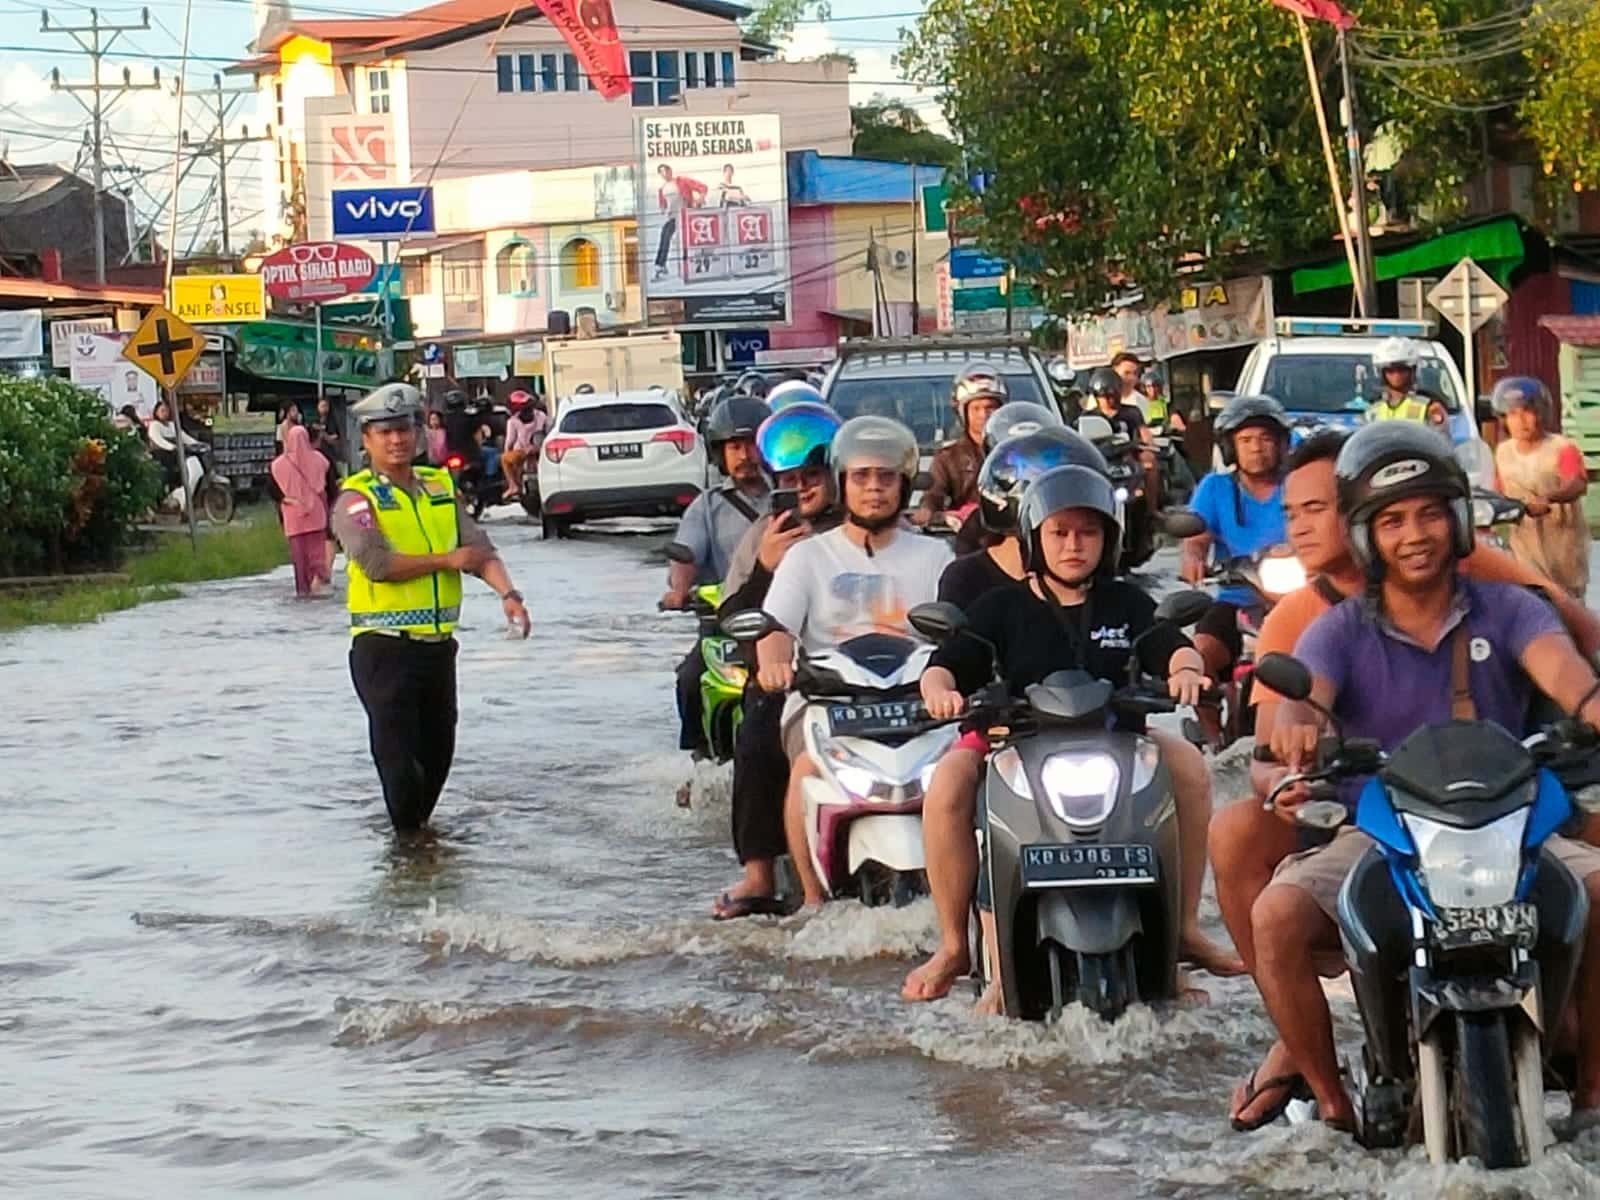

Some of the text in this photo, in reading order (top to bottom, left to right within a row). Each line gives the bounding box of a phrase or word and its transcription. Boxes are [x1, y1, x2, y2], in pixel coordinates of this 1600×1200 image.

[647, 120, 745, 138] SE-IYA SEKATA
[648, 140, 698, 157] SERUPA
[702, 138, 753, 155] SERASA
[346, 196, 423, 219] vivo
[262, 264, 298, 283] OPTIK
[339, 259, 372, 277] BARU
